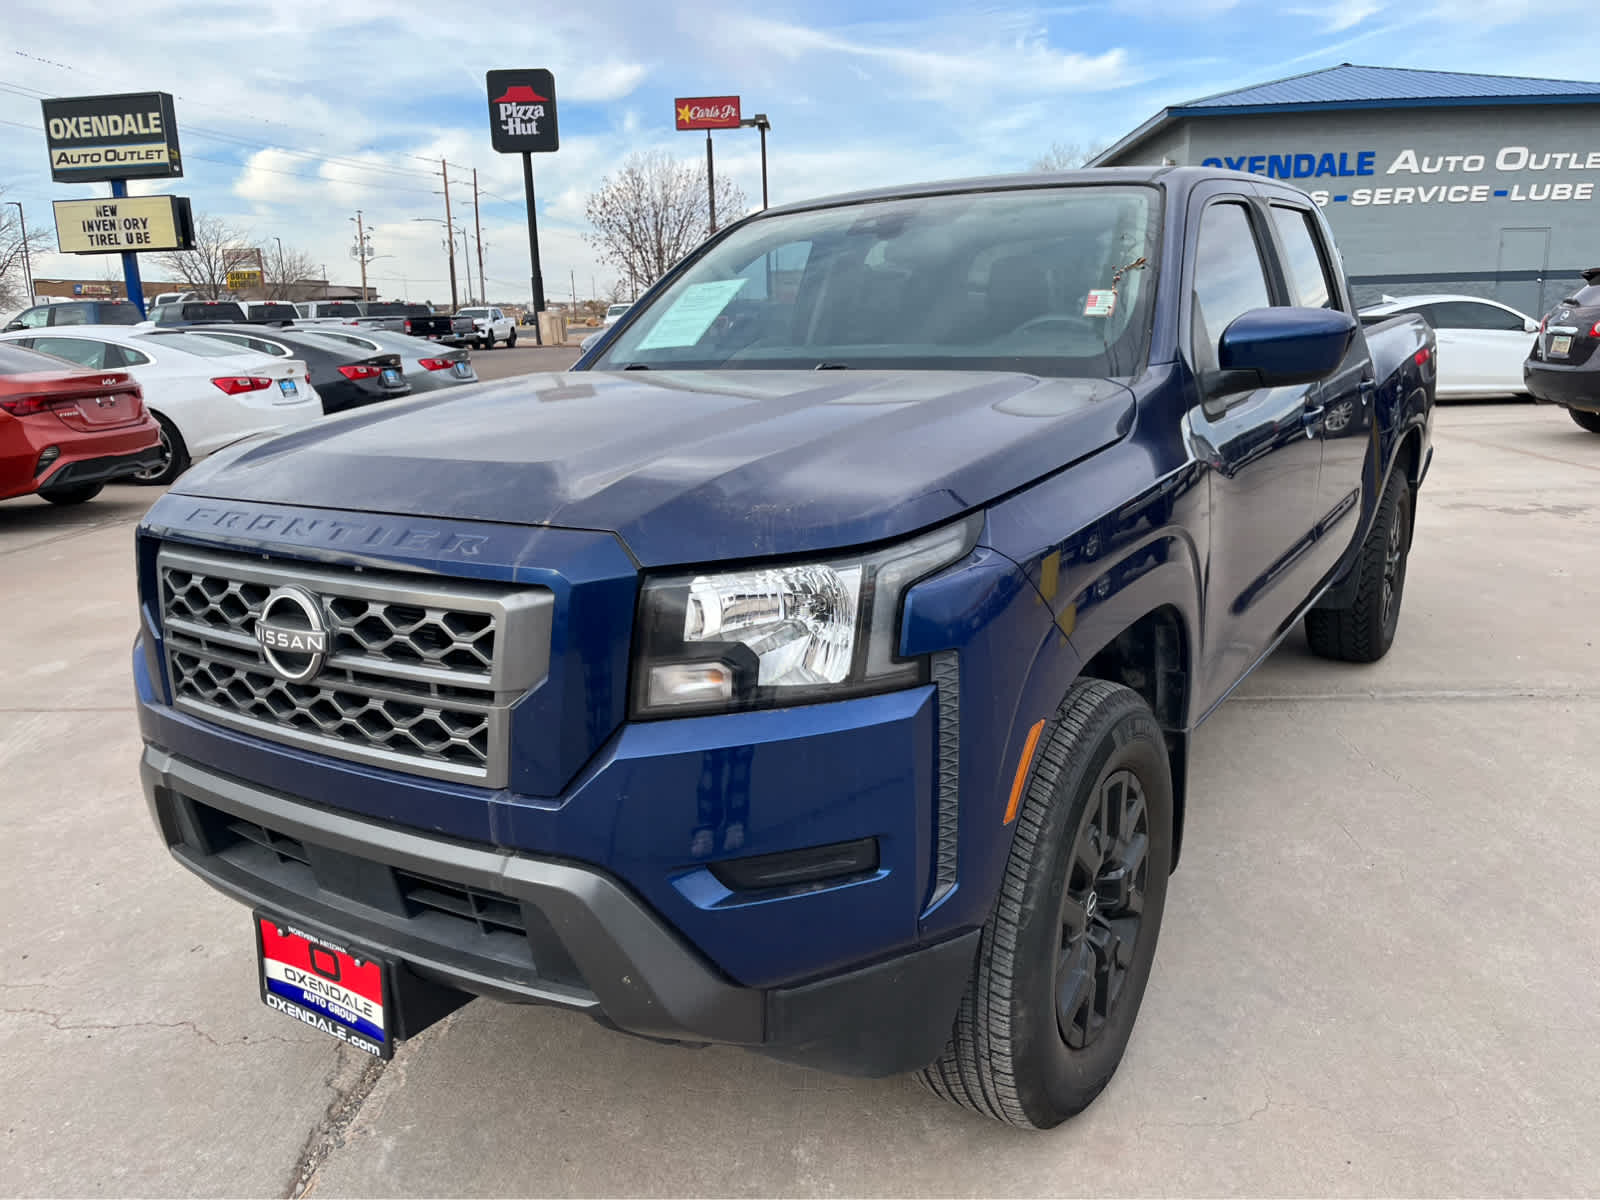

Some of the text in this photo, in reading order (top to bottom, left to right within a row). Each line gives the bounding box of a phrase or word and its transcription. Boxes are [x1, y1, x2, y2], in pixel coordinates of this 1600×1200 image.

[499, 102, 545, 120] Pizza
[49, 112, 161, 139] OXENDALE
[501, 117, 541, 136] Hut
[95, 204, 117, 217] NEW
[185, 507, 489, 555] FRONTIER
[255, 625, 323, 651] NISSAN
[284, 967, 373, 1018] OXENDALE
[303, 990, 358, 1024] AUTO GROUP
[266, 993, 380, 1056] OXENDALE.com
